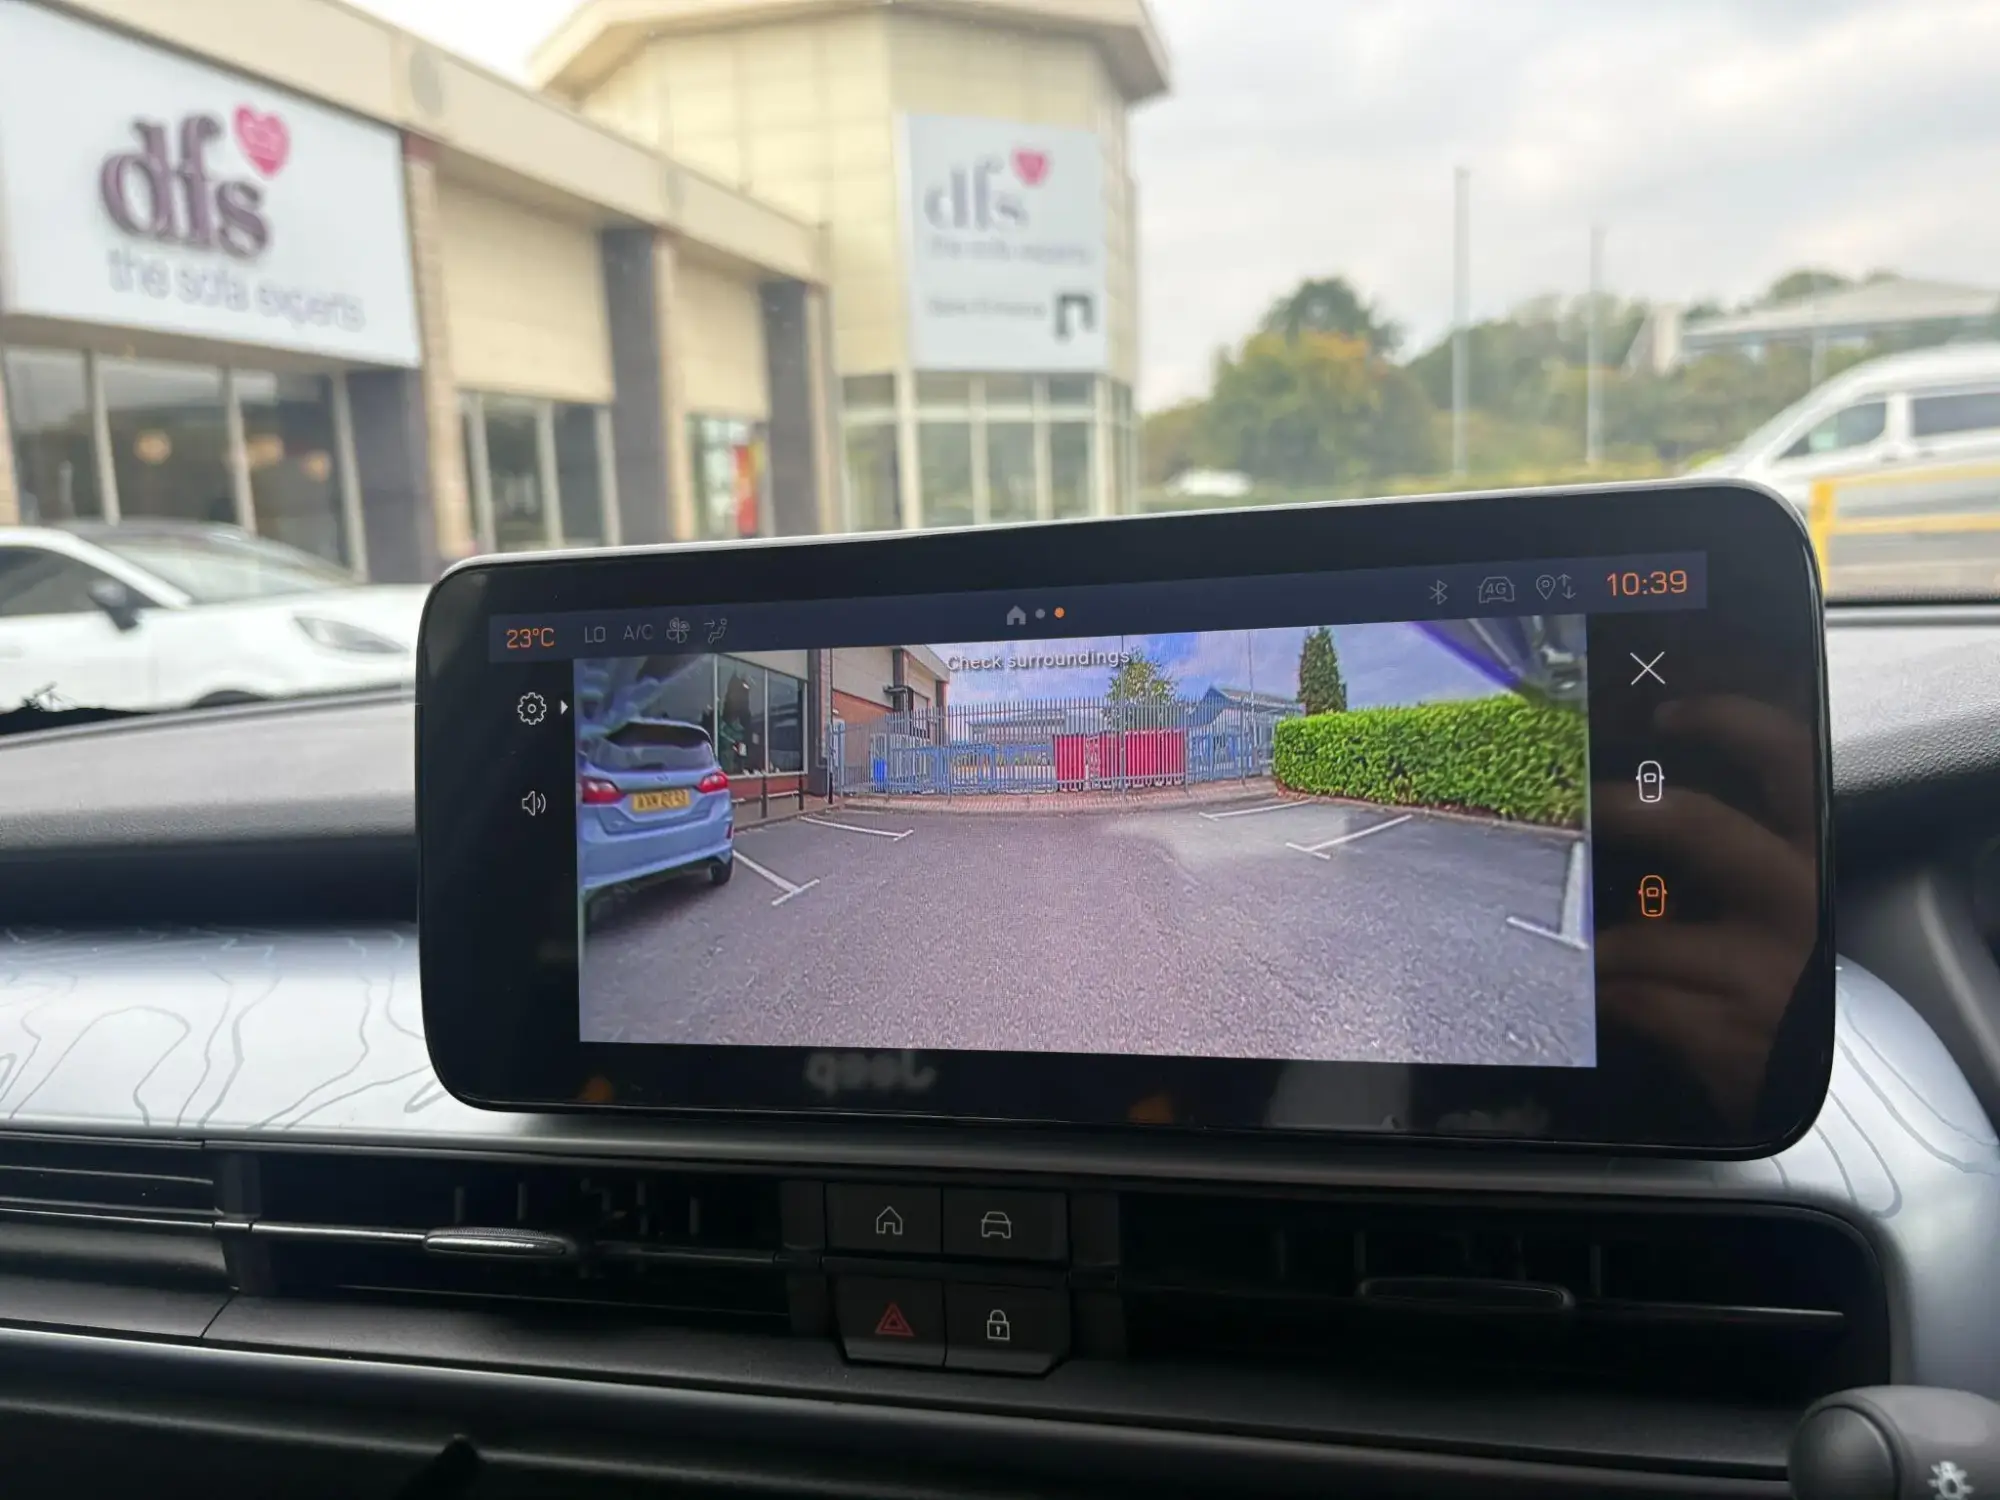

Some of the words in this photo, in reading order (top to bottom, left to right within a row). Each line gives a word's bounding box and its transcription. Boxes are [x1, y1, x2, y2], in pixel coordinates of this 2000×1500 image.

[100, 114, 271, 260] dfs
[924, 155, 1030, 232] dfs
[106, 249, 171, 299] the
[174, 264, 251, 312] sofa
[1484, 582, 1508, 597] 4G
[1606, 570, 1689, 597] 10:39
[506, 628, 555, 649] 23°C
[584, 626, 607, 644] LO
[622, 624, 653, 642] A/C
[947, 656, 1001, 672] Check
[1008, 649, 1130, 669] surroundings
